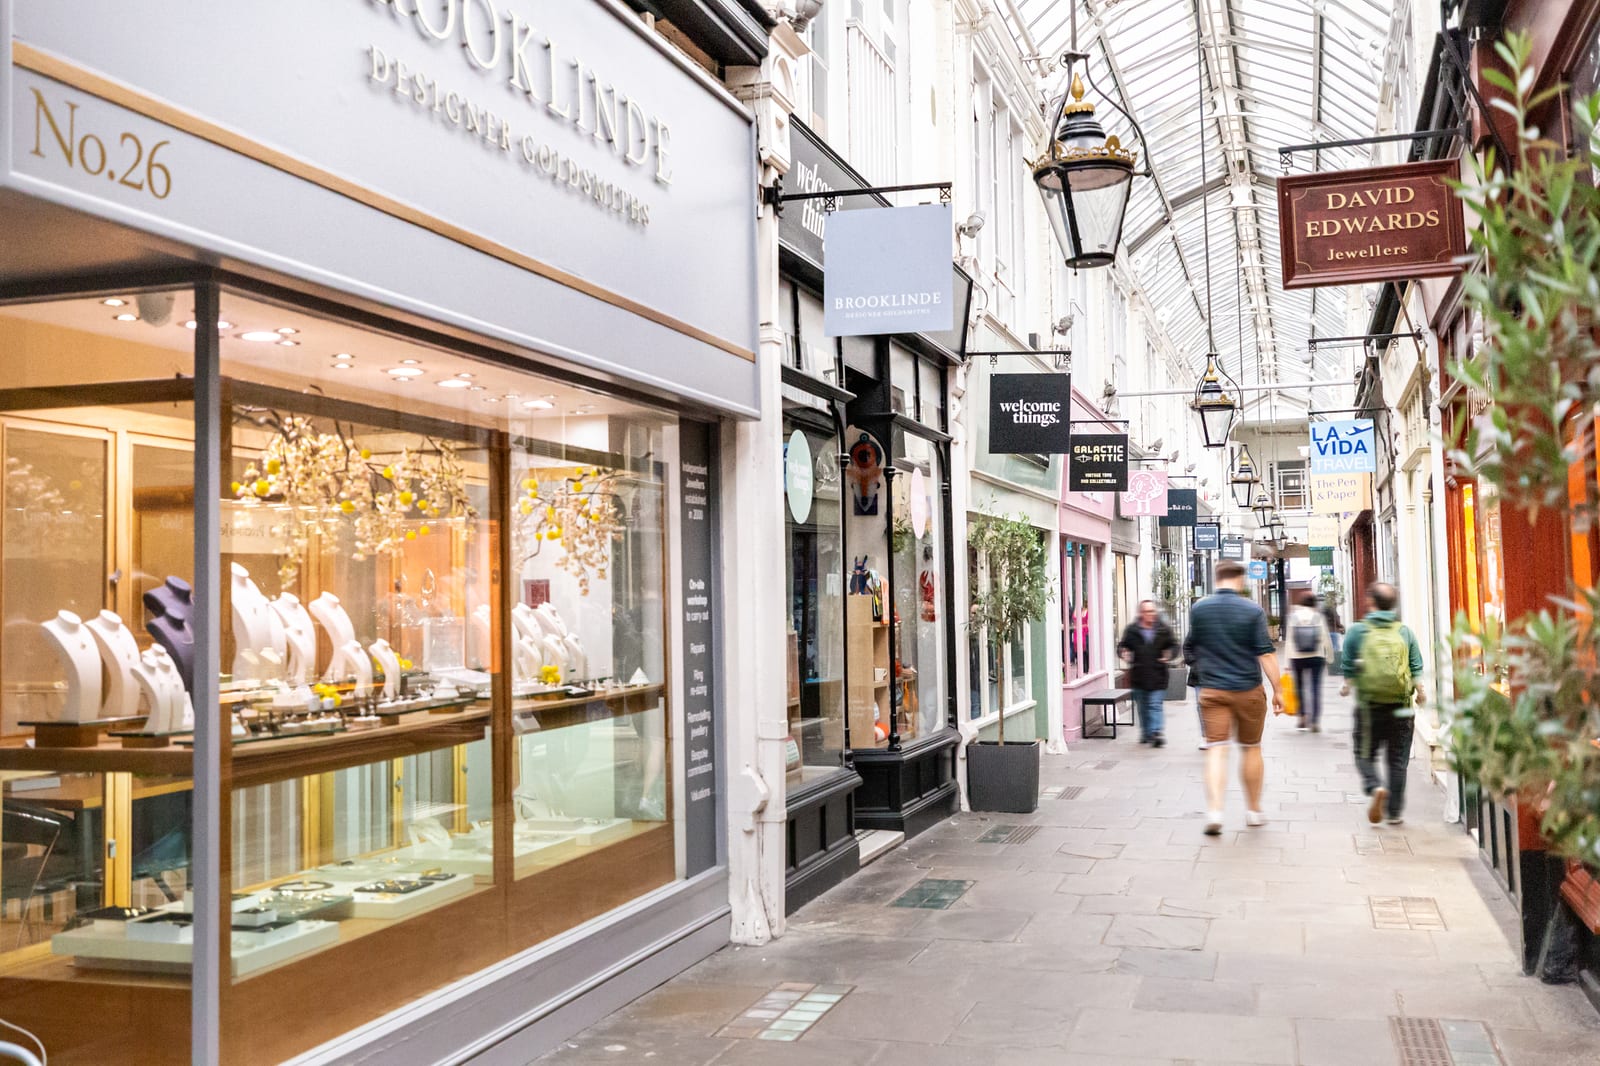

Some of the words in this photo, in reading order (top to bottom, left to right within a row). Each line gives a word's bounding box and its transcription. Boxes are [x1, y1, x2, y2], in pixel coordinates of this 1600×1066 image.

[370, 0, 673, 186] OOKLINDE
[29, 87, 172, 200] No.26
[369, 43, 512, 152] DESIGNER
[520, 134, 651, 227] GOLDSMITHS
[1326, 185, 1416, 211] DAVID
[801, 197, 825, 252] thin
[1305, 209, 1440, 239] EDWARDS
[1327, 244, 1409, 262] Jewellers
[835, 291, 942, 310] BROOKLINDE
[999, 398, 1061, 412] welcome
[1013, 410, 1060, 428] things.
[1311, 426, 1340, 442] LA
[1073, 445, 1124, 454] GALACTIC
[1316, 439, 1368, 456] VIDA
[1092, 453, 1124, 462] ATTIC
[1314, 456, 1374, 473] TRAVEL
[1316, 479, 1336, 489] The
[1337, 478, 1357, 488] Pen
[1316, 491, 1326, 501] &
[1327, 489, 1357, 502] Paper
